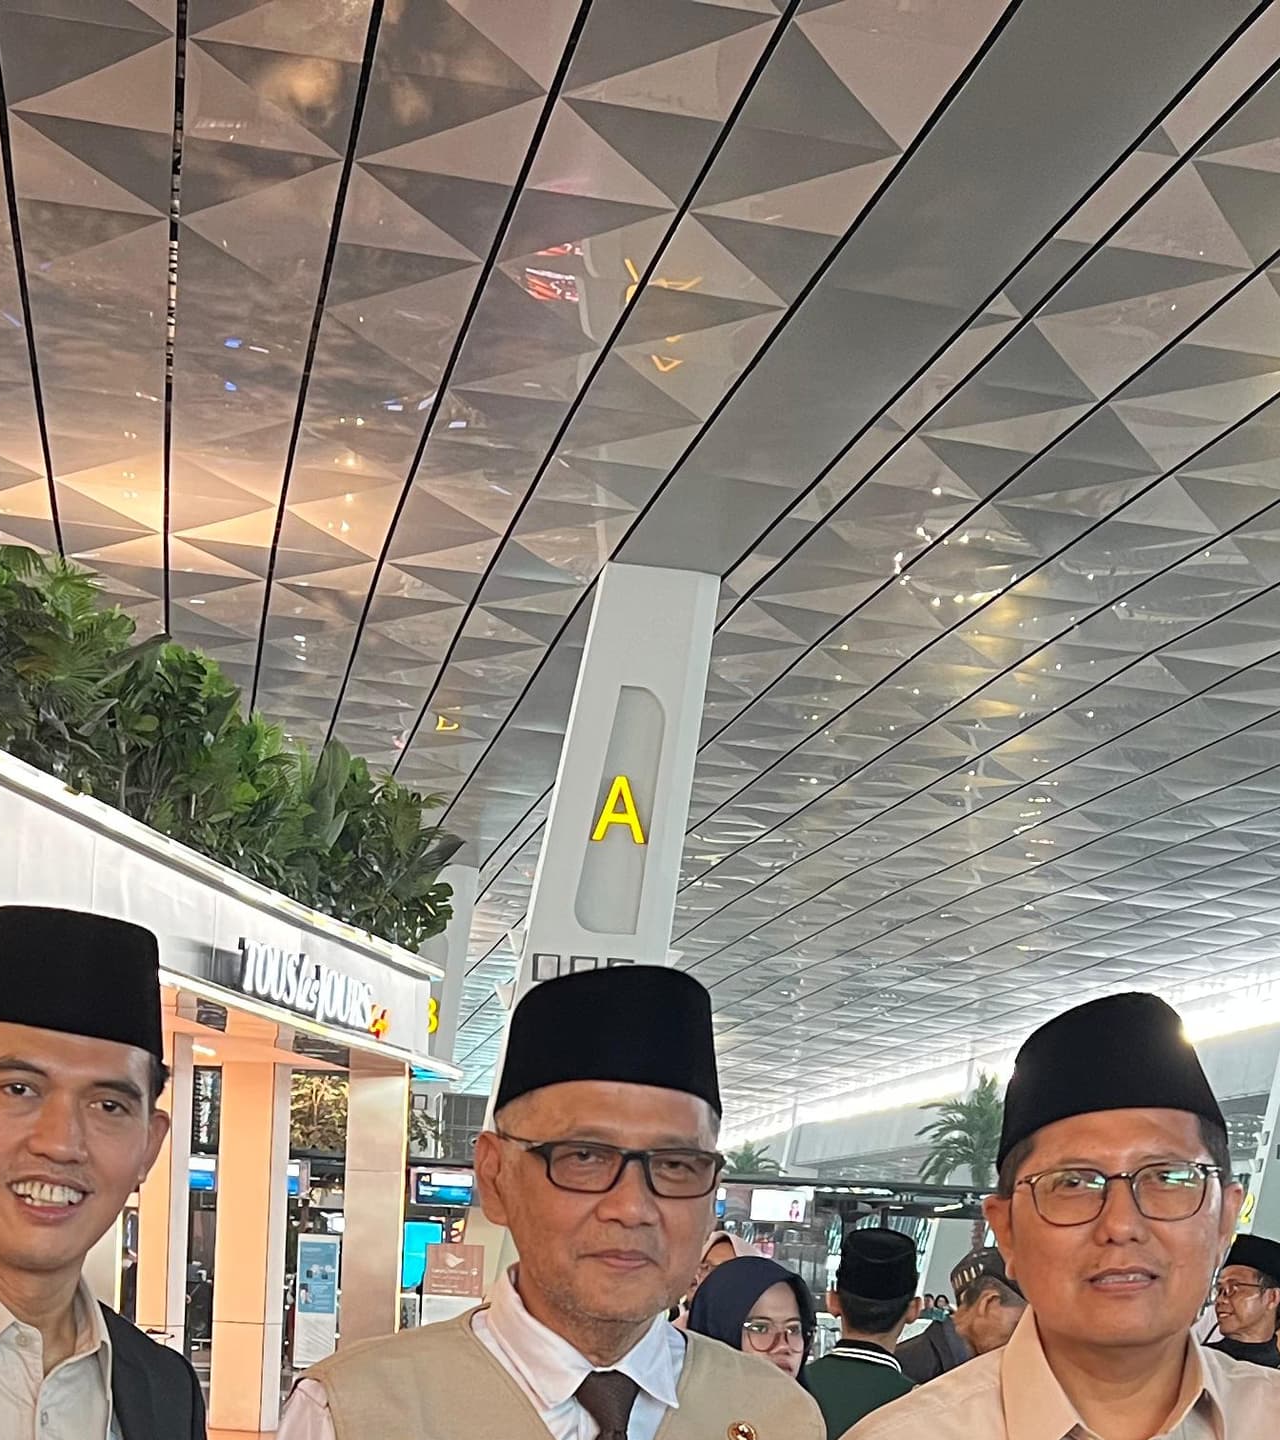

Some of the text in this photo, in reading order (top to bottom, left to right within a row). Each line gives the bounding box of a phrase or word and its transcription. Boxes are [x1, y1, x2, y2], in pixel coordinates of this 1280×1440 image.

[590, 775, 647, 845] A
[242, 937, 300, 1005] TOUS
[315, 964, 374, 1031] JOURS
